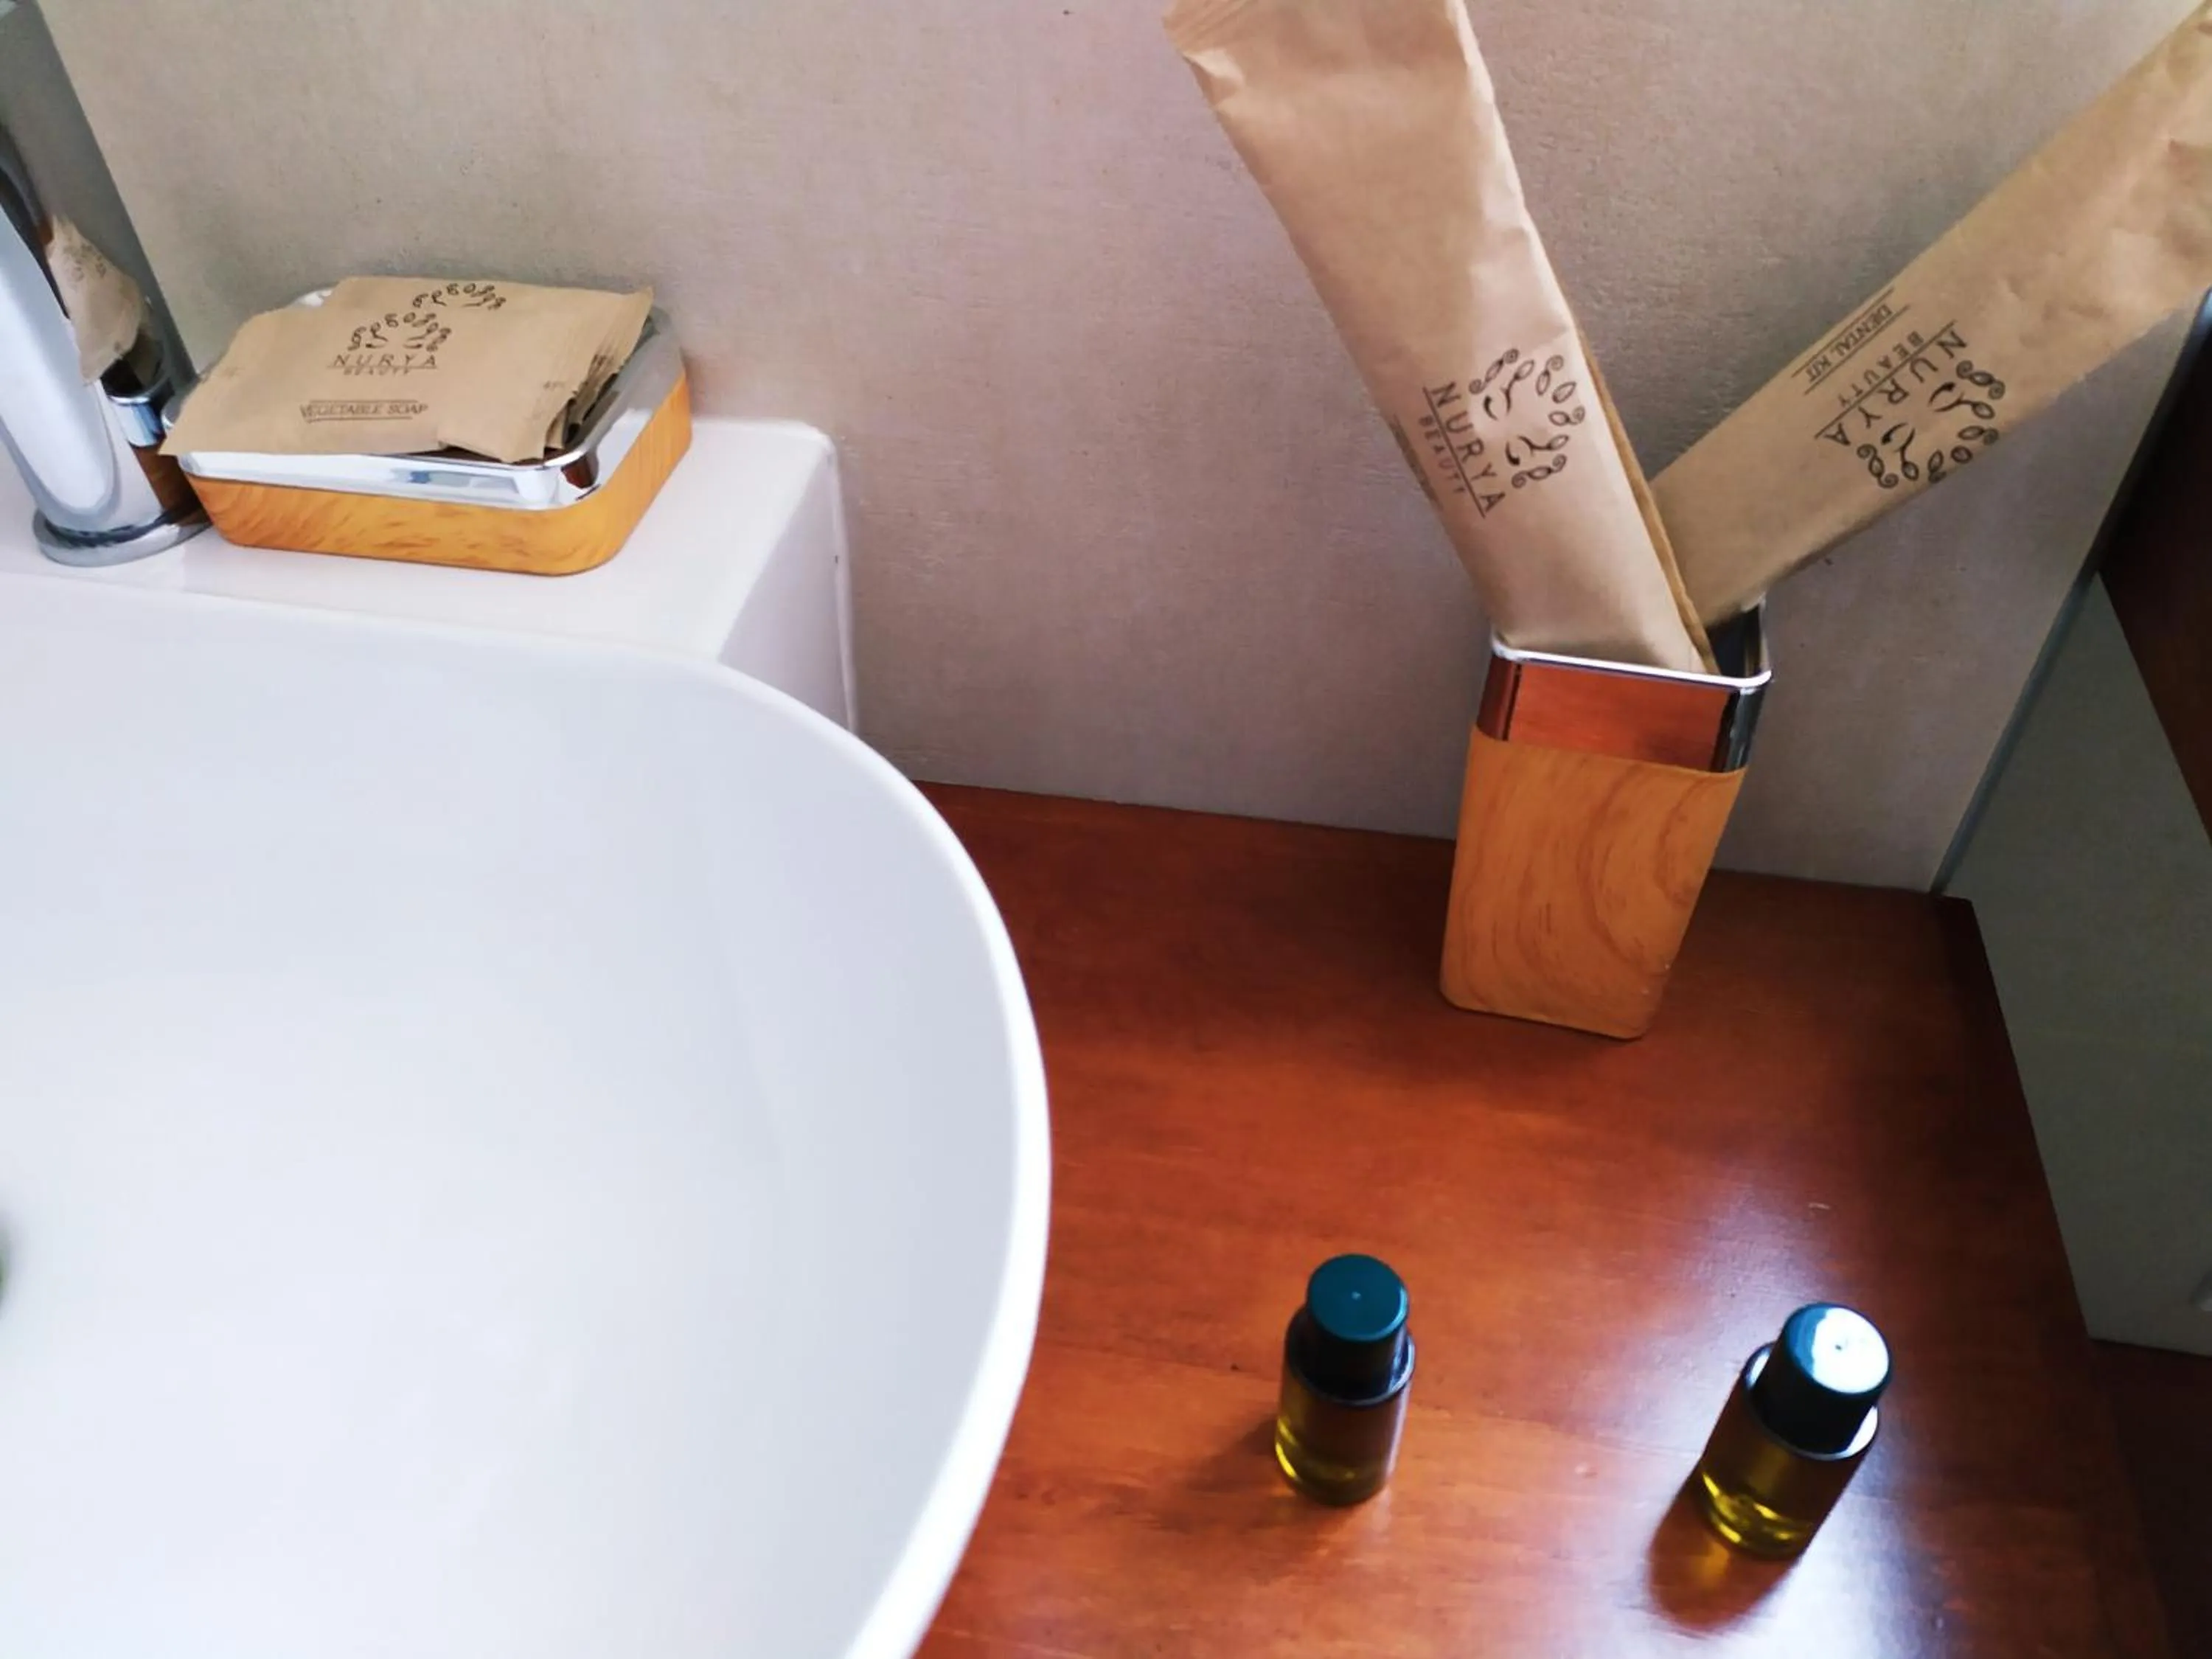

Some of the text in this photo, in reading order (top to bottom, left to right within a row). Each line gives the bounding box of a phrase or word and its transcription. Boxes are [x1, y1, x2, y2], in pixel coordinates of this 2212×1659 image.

[334, 354, 436, 367] NURYA
[1805, 305, 1893, 382] DENTAL KIT
[1838, 331, 1924, 406] BEAUTY
[1821, 330, 1967, 447] NURYA
[1419, 414, 1466, 493] BEAUTY
[1430, 381, 1506, 512] NURYA
